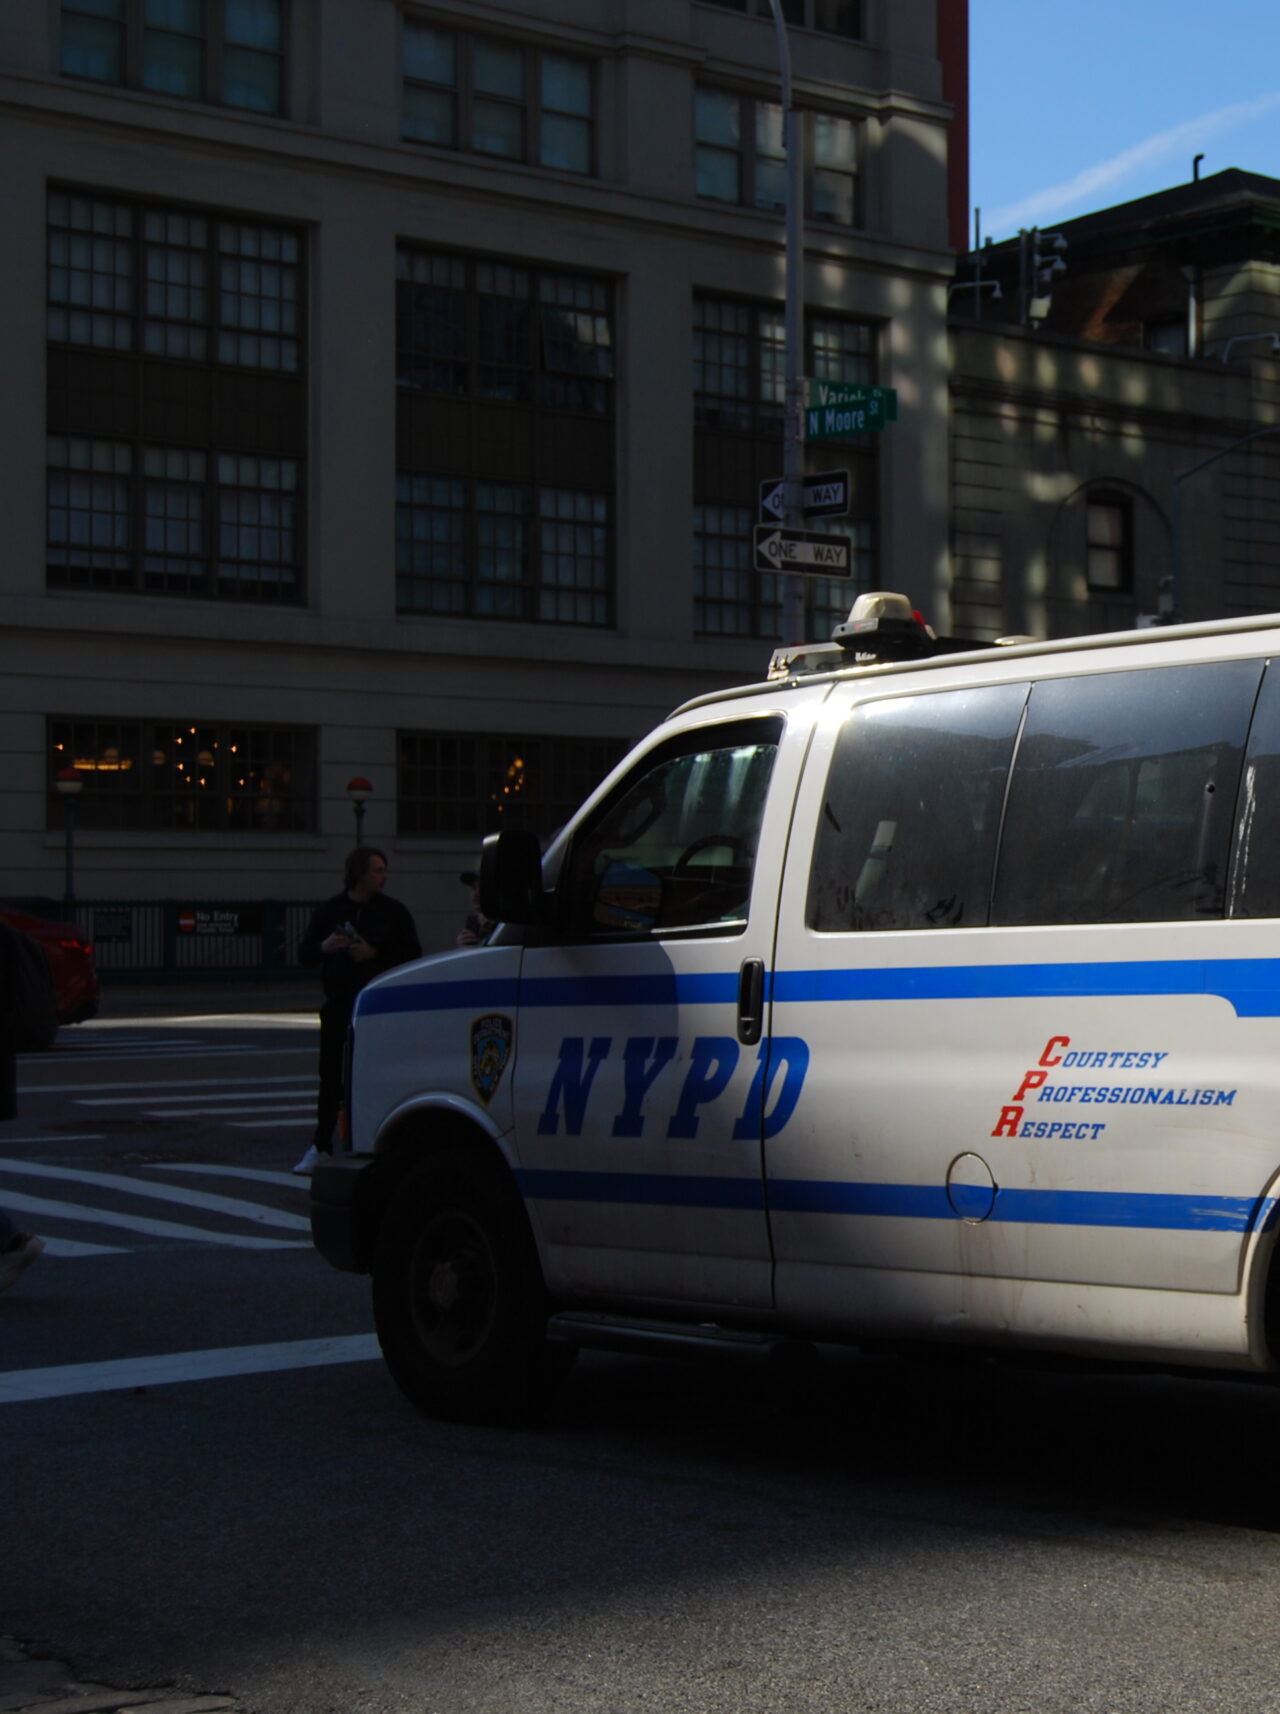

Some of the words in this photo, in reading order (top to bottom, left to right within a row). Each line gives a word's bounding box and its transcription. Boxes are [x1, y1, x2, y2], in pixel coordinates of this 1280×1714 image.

[809, 410, 819, 436] N
[825, 408, 865, 432] Moore
[812, 485, 842, 504] WAY
[768, 541, 797, 559] ONE
[813, 545, 843, 563] WAY
[196, 911, 210, 921] No
[213, 910, 240, 922] Entry
[536, 1036, 810, 1141] NYPD
